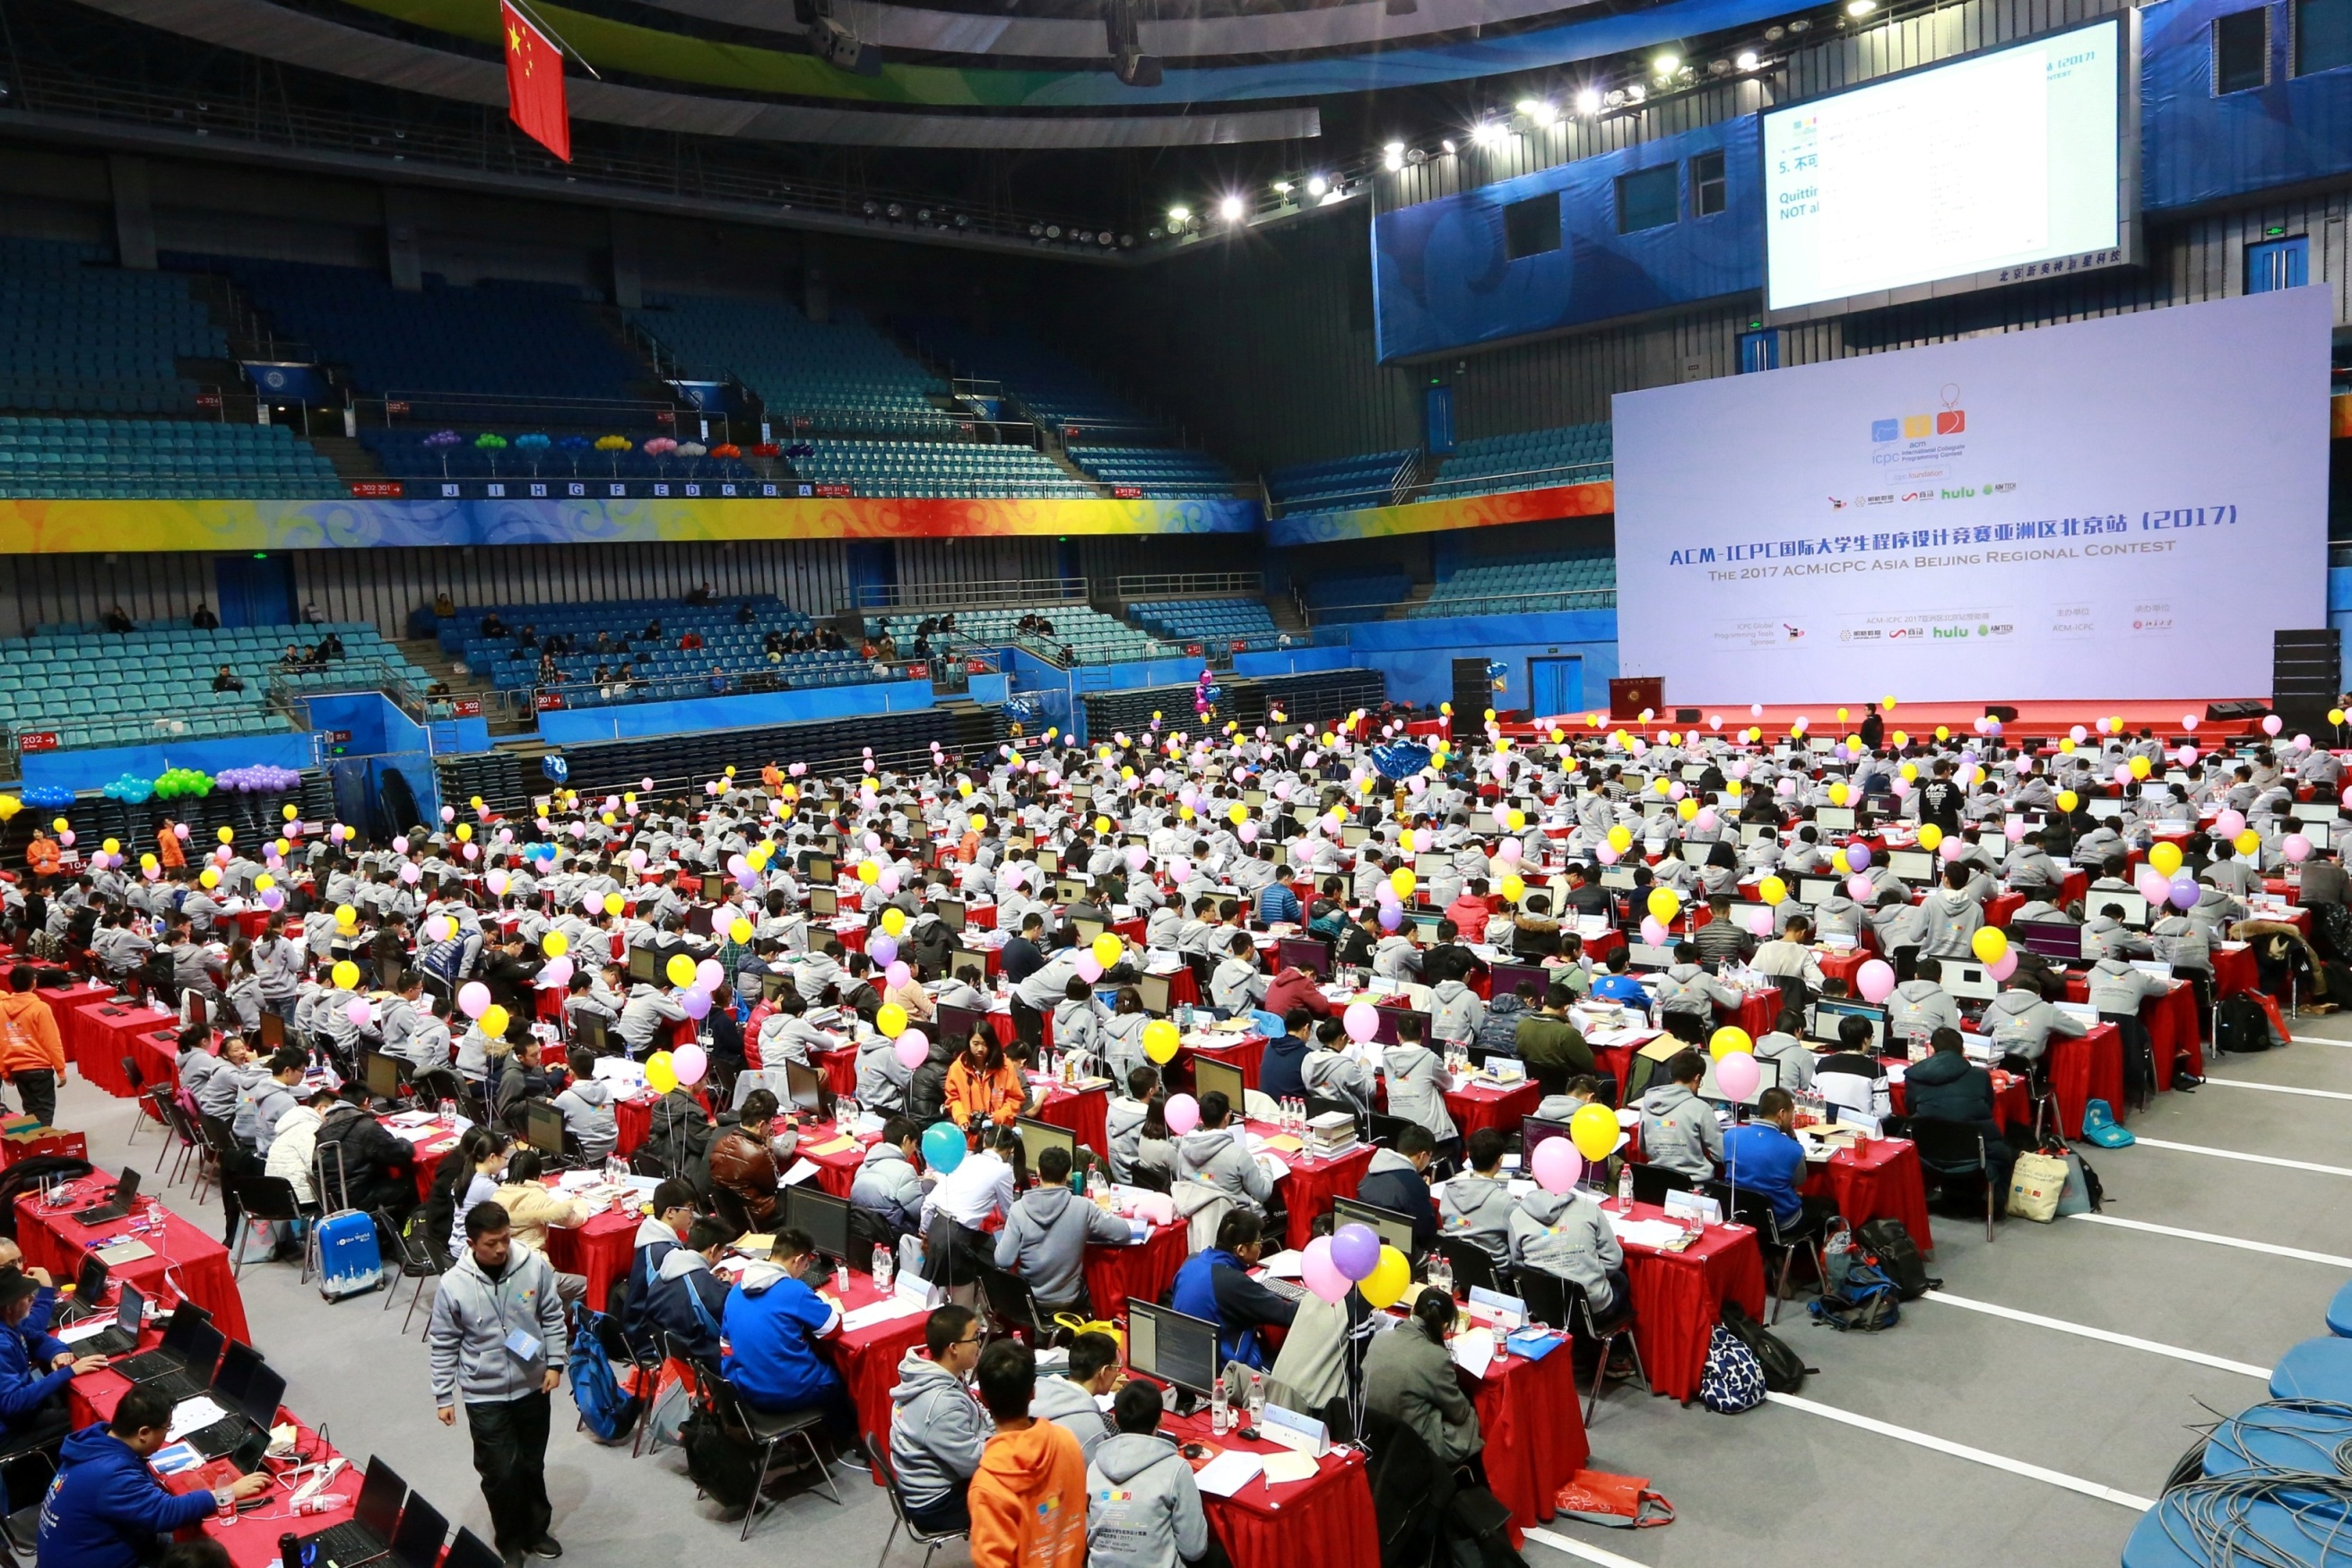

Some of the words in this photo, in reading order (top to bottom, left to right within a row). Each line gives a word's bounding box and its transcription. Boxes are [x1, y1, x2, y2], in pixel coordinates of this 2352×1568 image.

[1779, 161, 1791, 174] 5.
[1781, 204, 1807, 221] NOT
[1872, 452, 1900, 466] icpc
[1902, 446, 1936, 455] International
[1937, 444, 1966, 452] Collegiate
[1902, 454, 1939, 462] Programming
[1909, 469, 1943, 479] foundation
[447, 485, 455, 496] J
[534, 485, 543, 496] H
[573, 484, 581, 495] G
[614, 485, 621, 495] F
[658, 485, 664, 495] E
[689, 485, 696, 495] D
[725, 485, 733, 495] C
[767, 485, 773, 495] B
[802, 486, 809, 495] A
[1941, 486, 1975, 499] hulu
[1740, 567, 1778, 580] 2017
[1783, 559, 1866, 576] ACM-ICPC
[1933, 626, 1968, 638] hulu
[2053, 623, 2095, 632] ACM-ICPC
[1714, 631, 1756, 639] Programming
[464, 701, 479, 710] 202
[22, 736, 43, 744] 202
[68, 861, 88, 870] 104
